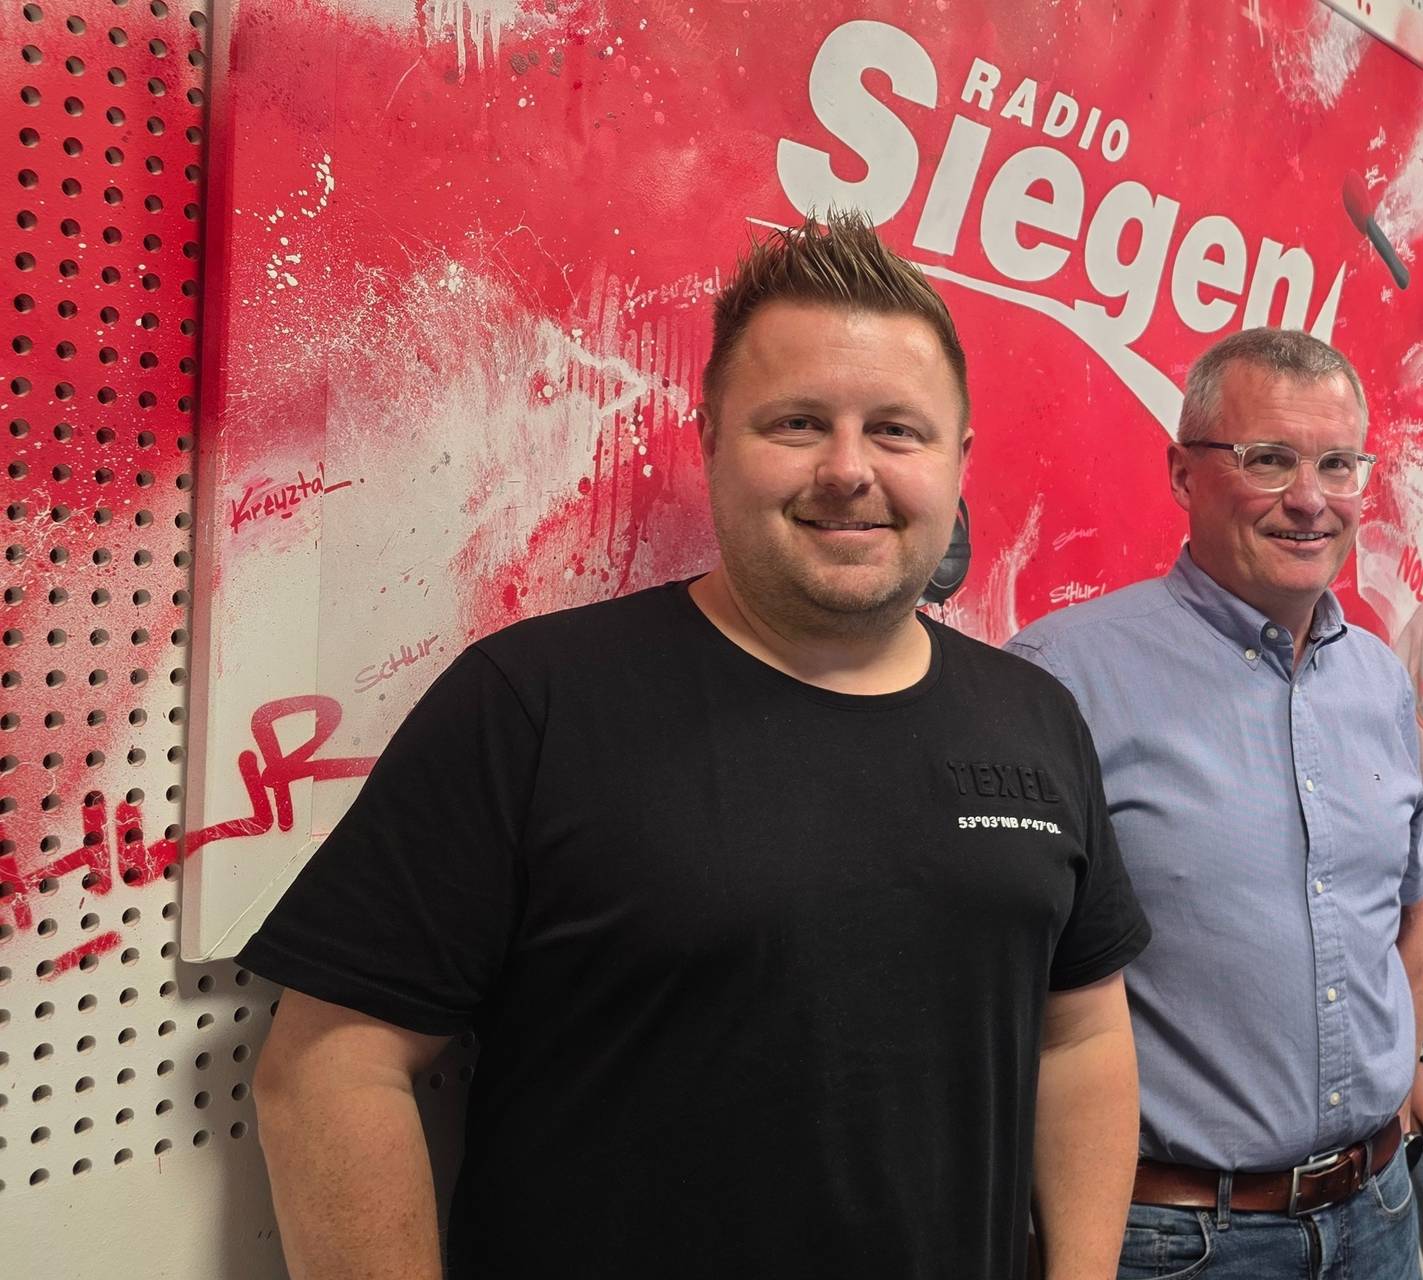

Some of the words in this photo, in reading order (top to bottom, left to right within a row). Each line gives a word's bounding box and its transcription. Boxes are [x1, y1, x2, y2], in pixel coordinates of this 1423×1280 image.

[961, 57, 1130, 163] RADIO
[776, 19, 1316, 347] Siegen
[946, 761, 1060, 804] TEXEL
